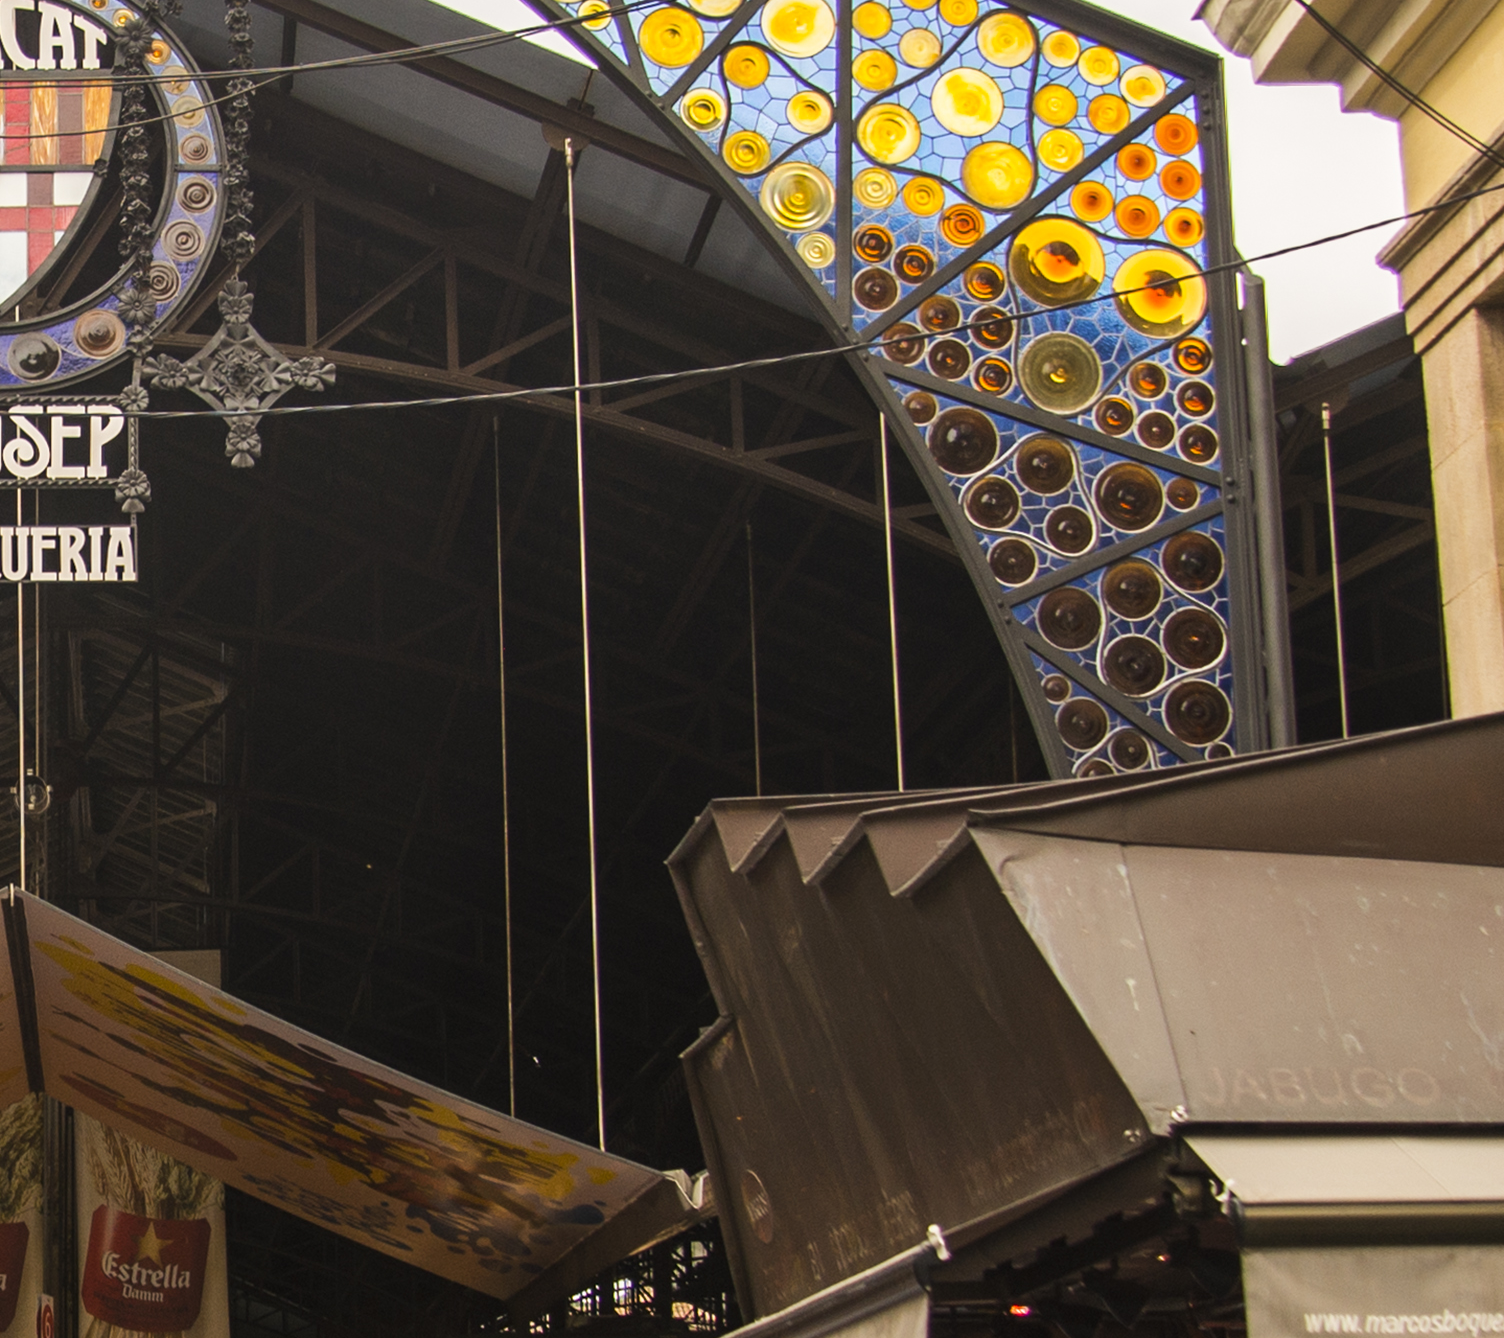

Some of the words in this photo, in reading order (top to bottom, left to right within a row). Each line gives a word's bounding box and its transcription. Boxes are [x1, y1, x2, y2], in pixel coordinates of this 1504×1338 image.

[1199, 1064, 1441, 1107] JABUGO
[101, 1249, 192, 1291] Estrella
[122, 1283, 165, 1303] Damm
